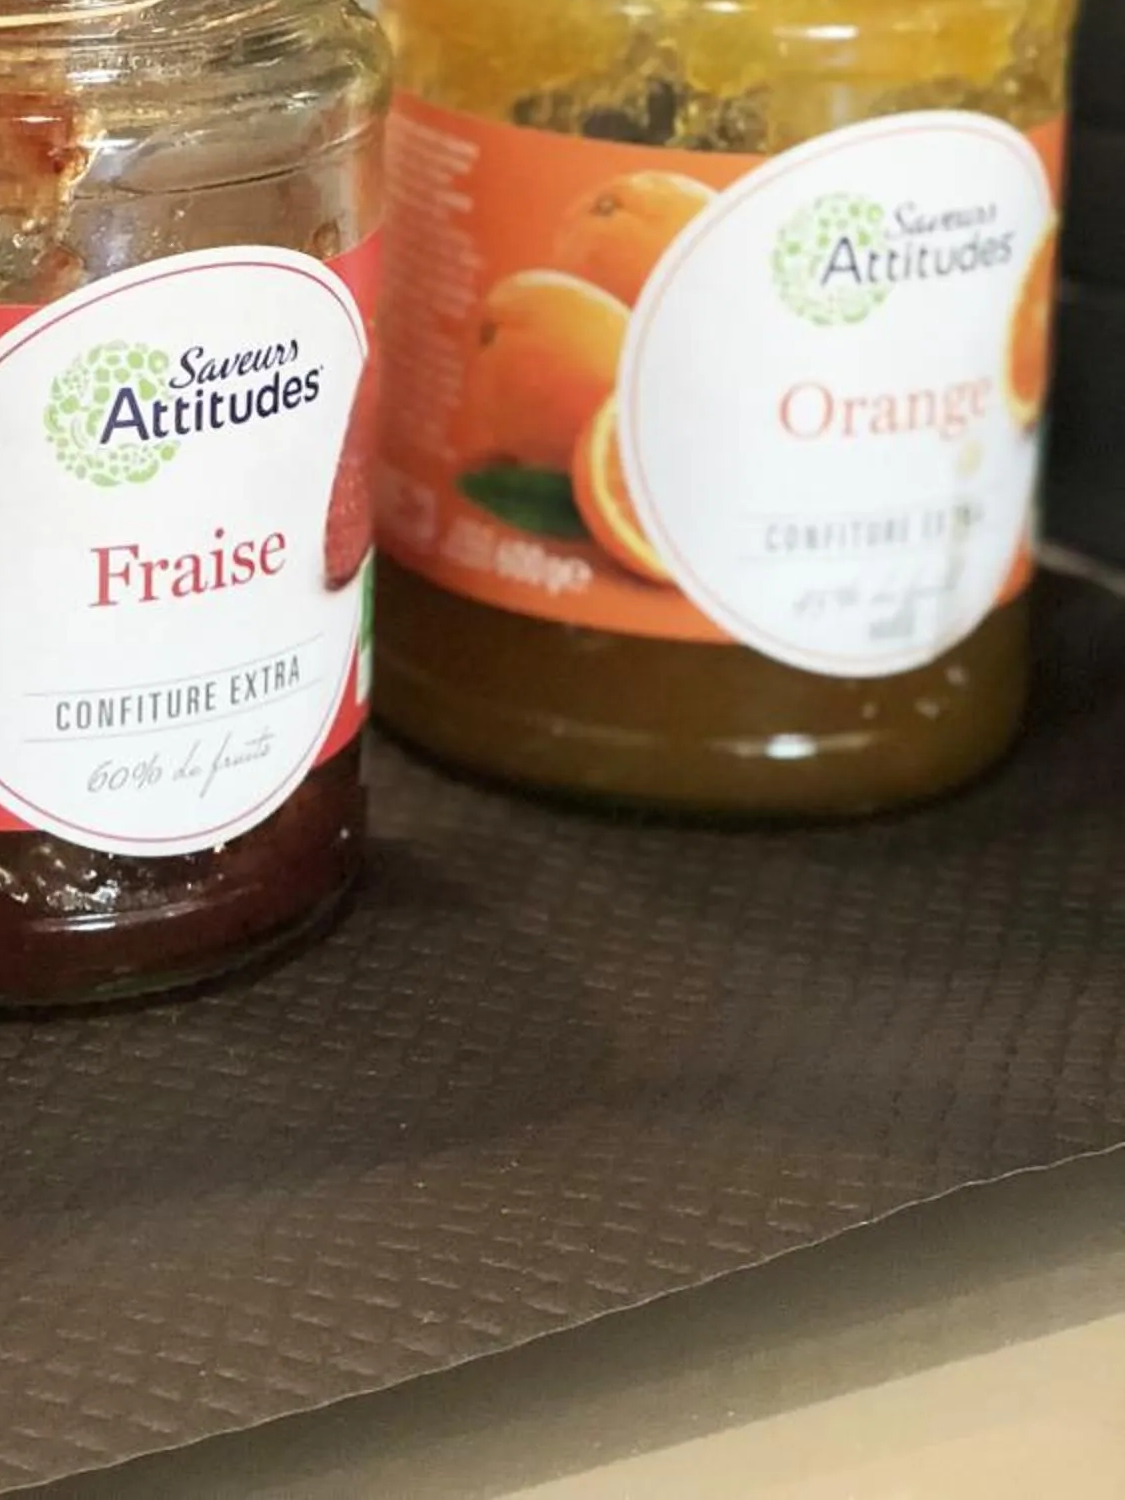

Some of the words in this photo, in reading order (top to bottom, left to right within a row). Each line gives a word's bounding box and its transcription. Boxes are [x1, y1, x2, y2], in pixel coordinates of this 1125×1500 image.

[820, 231, 1015, 286] Attitudes
[168, 338, 299, 389] Saveurs
[100, 368, 321, 445] Attitudes
[779, 377, 992, 441] Orange
[89, 528, 287, 607] Fraise
[56, 681, 217, 730] CONFITURE
[230, 655, 300, 705] EXTRA
